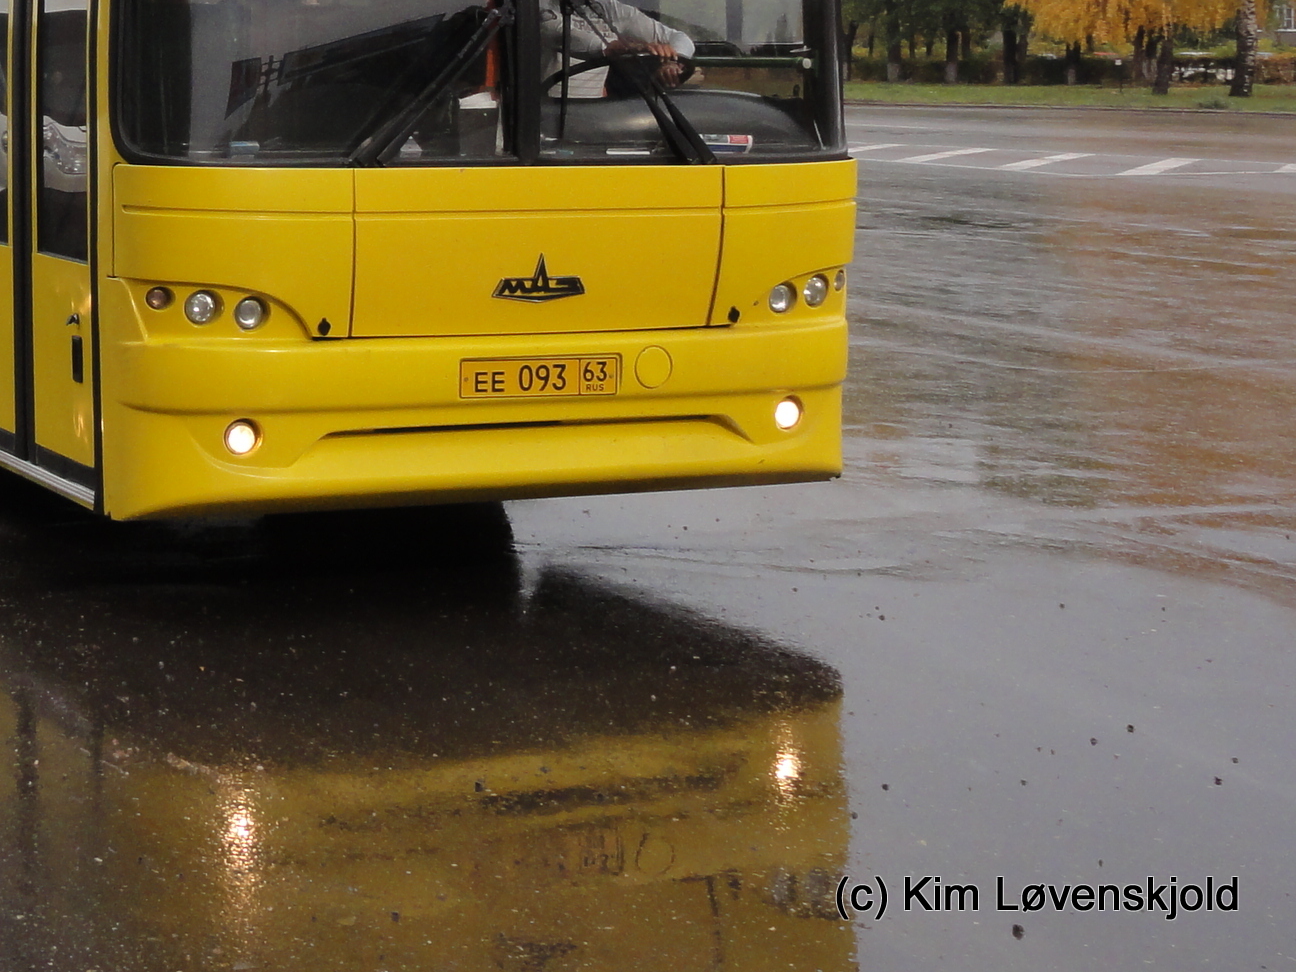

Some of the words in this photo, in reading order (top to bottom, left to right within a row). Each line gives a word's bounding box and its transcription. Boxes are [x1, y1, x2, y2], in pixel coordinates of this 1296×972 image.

[518, 364, 567, 392] 093
[582, 361, 608, 382] 63
[585, 383, 605, 392] RUS
